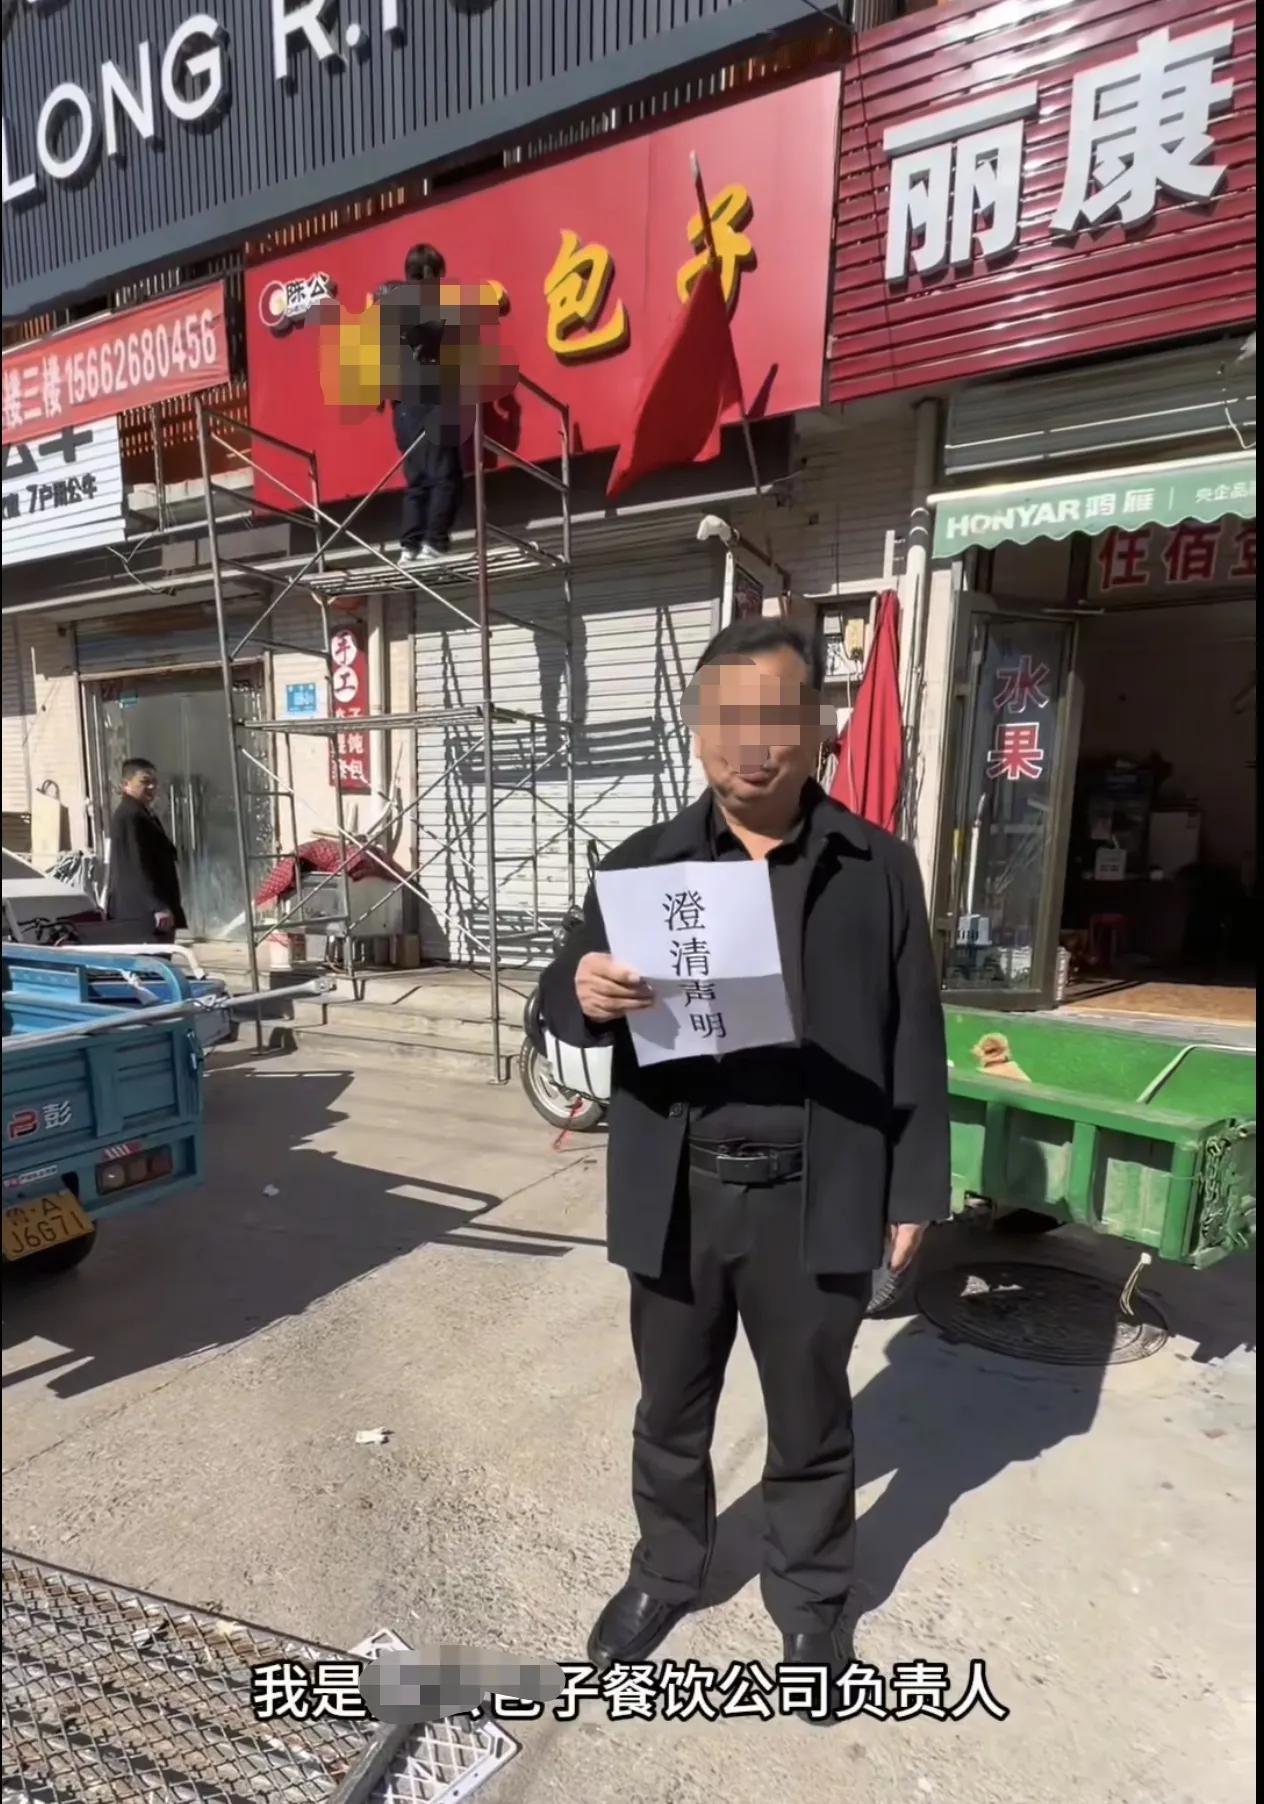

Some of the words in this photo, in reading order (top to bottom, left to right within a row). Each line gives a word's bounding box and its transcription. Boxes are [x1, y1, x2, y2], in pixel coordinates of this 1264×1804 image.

[883, 20, 1235, 280] 丽康
[947, 498, 1080, 538] HONYAR
[1194, 481, 1256, 503] 央企品
[987, 655, 1050, 780] 水果
[662, 890, 727, 1038] 澄清声明
[12, 1211, 85, 1253] J6G71
